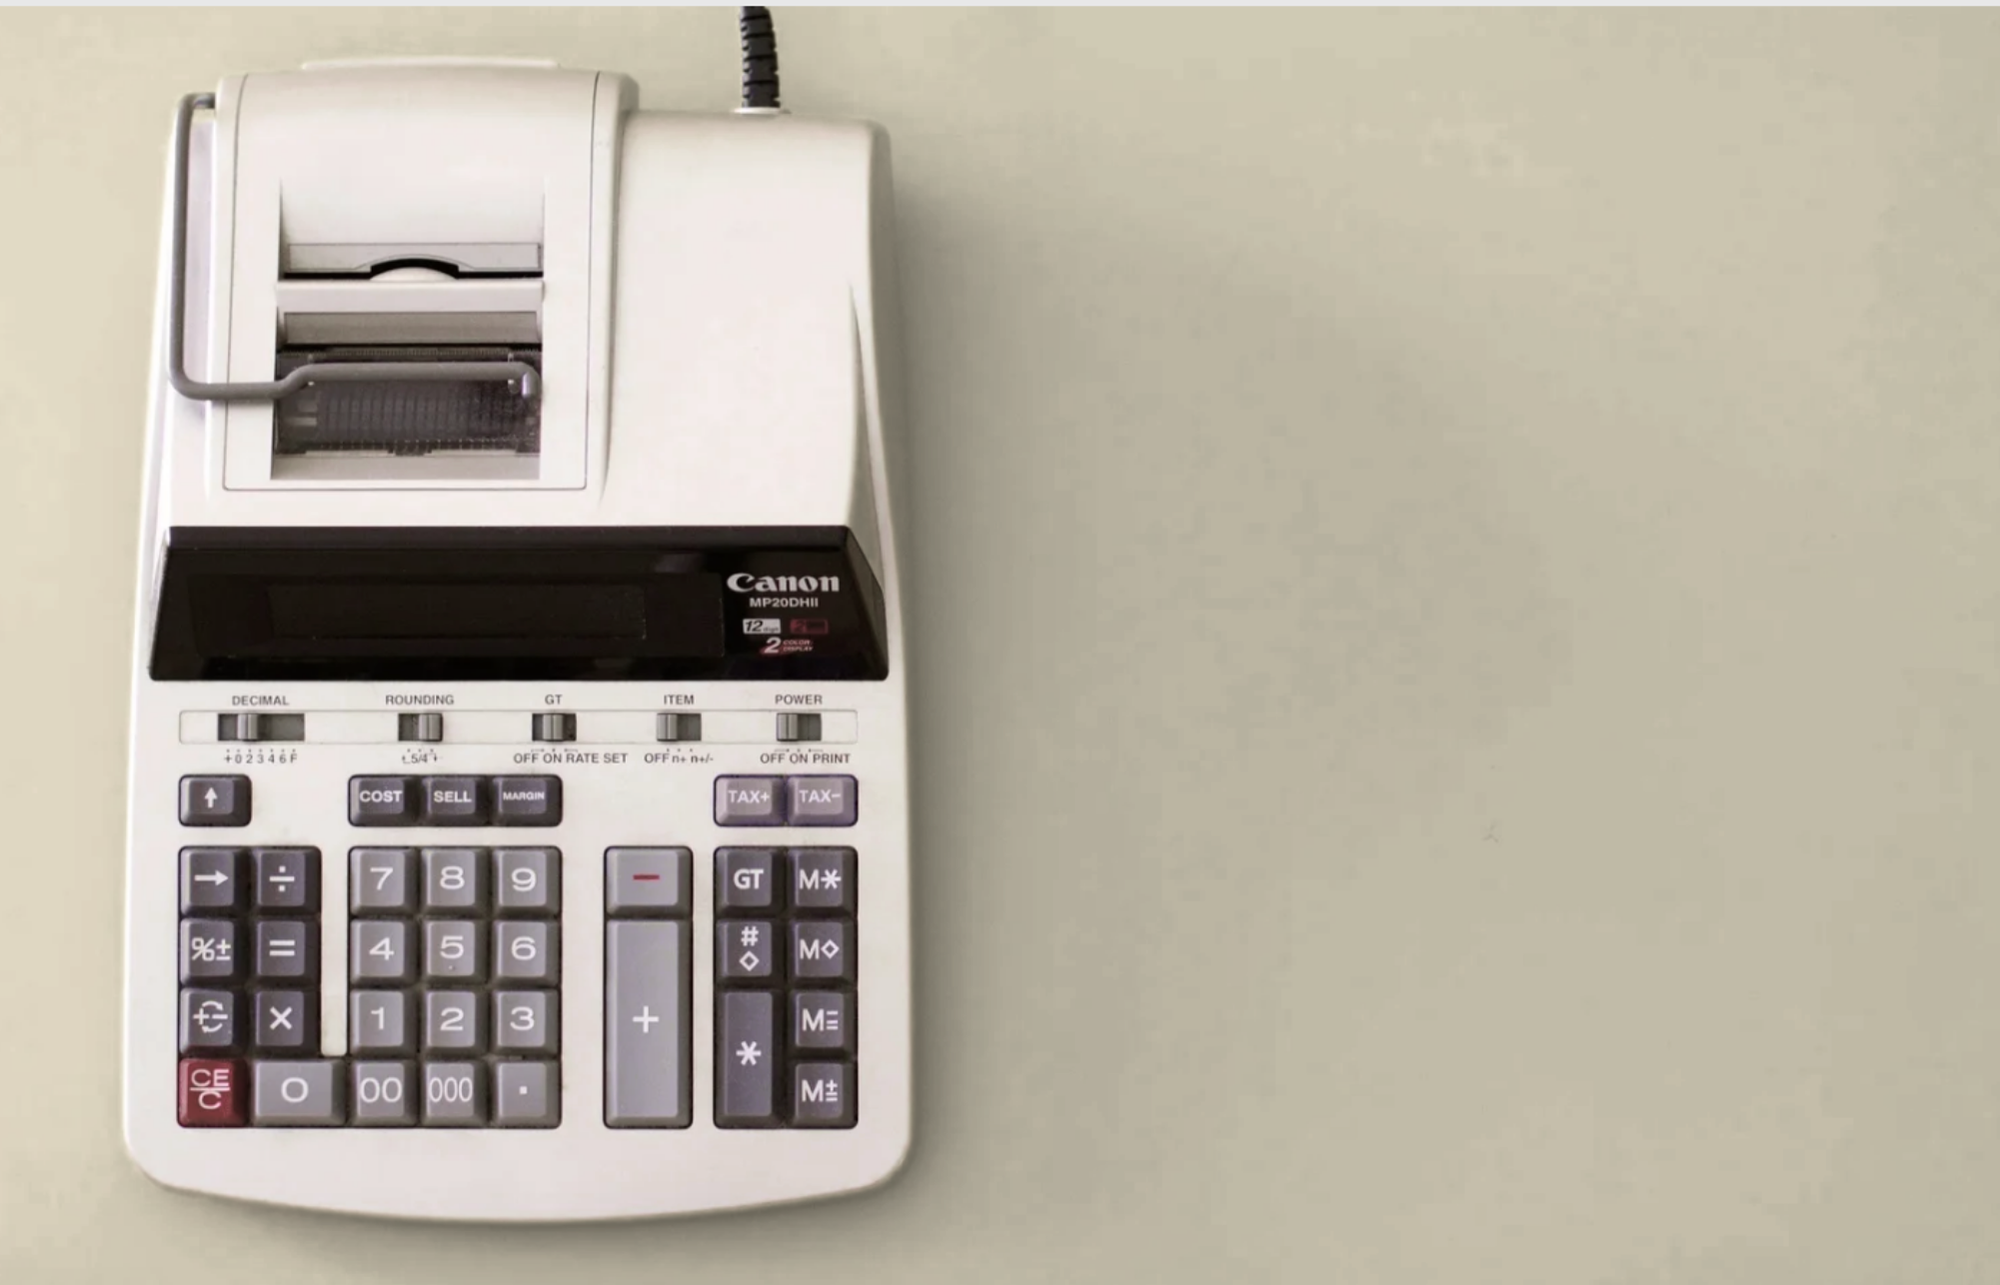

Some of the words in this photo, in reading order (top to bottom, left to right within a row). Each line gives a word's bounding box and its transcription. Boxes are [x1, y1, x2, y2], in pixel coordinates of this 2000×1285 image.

[727, 573, 840, 592] Canon
[749, 597, 819, 608] MP20DHII
[745, 620, 763, 632] 12
[764, 637, 781, 653] 2
[231, 695, 288, 706] DECIMAL
[385, 694, 455, 705] ROUNDING
[544, 694, 562, 705] GT
[663, 694, 694, 705] ITEM
[775, 694, 823, 705] POWER
[513, 753, 539, 763] OFF
[543, 753, 562, 763] ON
[566, 753, 599, 763] RATE
[603, 753, 628, 763] SET
[644, 753, 670, 763] OFF
[760, 753, 785, 764] OFF
[789, 753, 808, 764] ON
[812, 753, 851, 764] PRINT
[359, 790, 403, 802] COST
[433, 790, 472, 803] SELL
[503, 791, 545, 801] MARGIN
[728, 790, 770, 804] TAX+
[370, 867, 394, 891] 7
[440, 865, 465, 890] 8
[511, 867, 537, 892] 9
[733, 868, 764, 890] GT
[369, 937, 395, 961] 4
[440, 935, 465, 959] 5
[511, 936, 537, 961] 6
[371, 1006, 385, 1030] 1
[440, 1007, 464, 1031] 2
[510, 1006, 535, 1031] 3
[190, 1068, 231, 1088] CE
[358, 1077, 403, 1103] 00
[428, 1076, 473, 1103] 000
[197, 1090, 223, 1110] C
